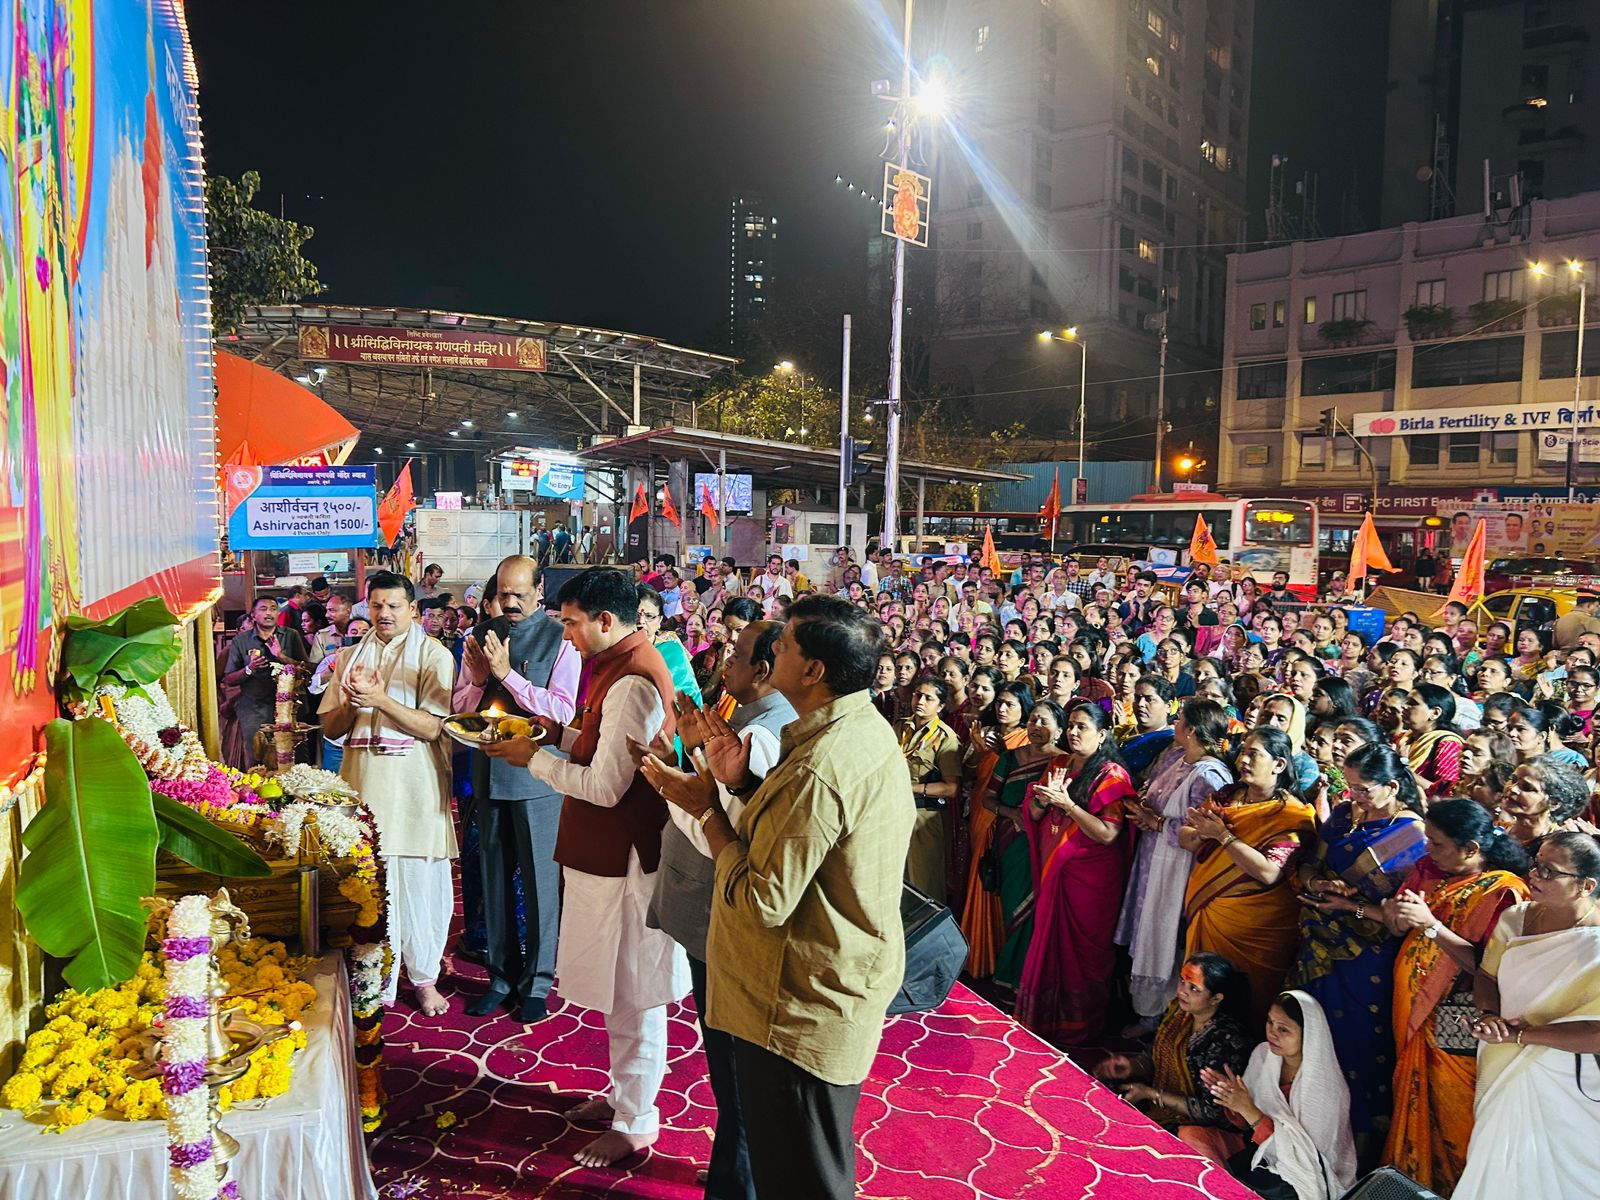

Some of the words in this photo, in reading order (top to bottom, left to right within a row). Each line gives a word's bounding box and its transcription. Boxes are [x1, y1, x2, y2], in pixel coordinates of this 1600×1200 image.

[435, 340, 471, 354] गणपती
[473, 340, 498, 356] मंदिर
[1399, 416, 1434, 431] Birla
[1439, 414, 1500, 431] Fertility
[1504, 413, 1517, 426] &
[1522, 411, 1550, 425] IVF
[557, 482, 571, 491] Entry
[260, 498, 319, 513] आशीर्वचन
[323, 501, 361, 514] १५००/-
[1393, 497, 1428, 507] FIRST
[253, 519, 330, 531] Ashirvachan
[334, 518, 369, 530] 1500/-
